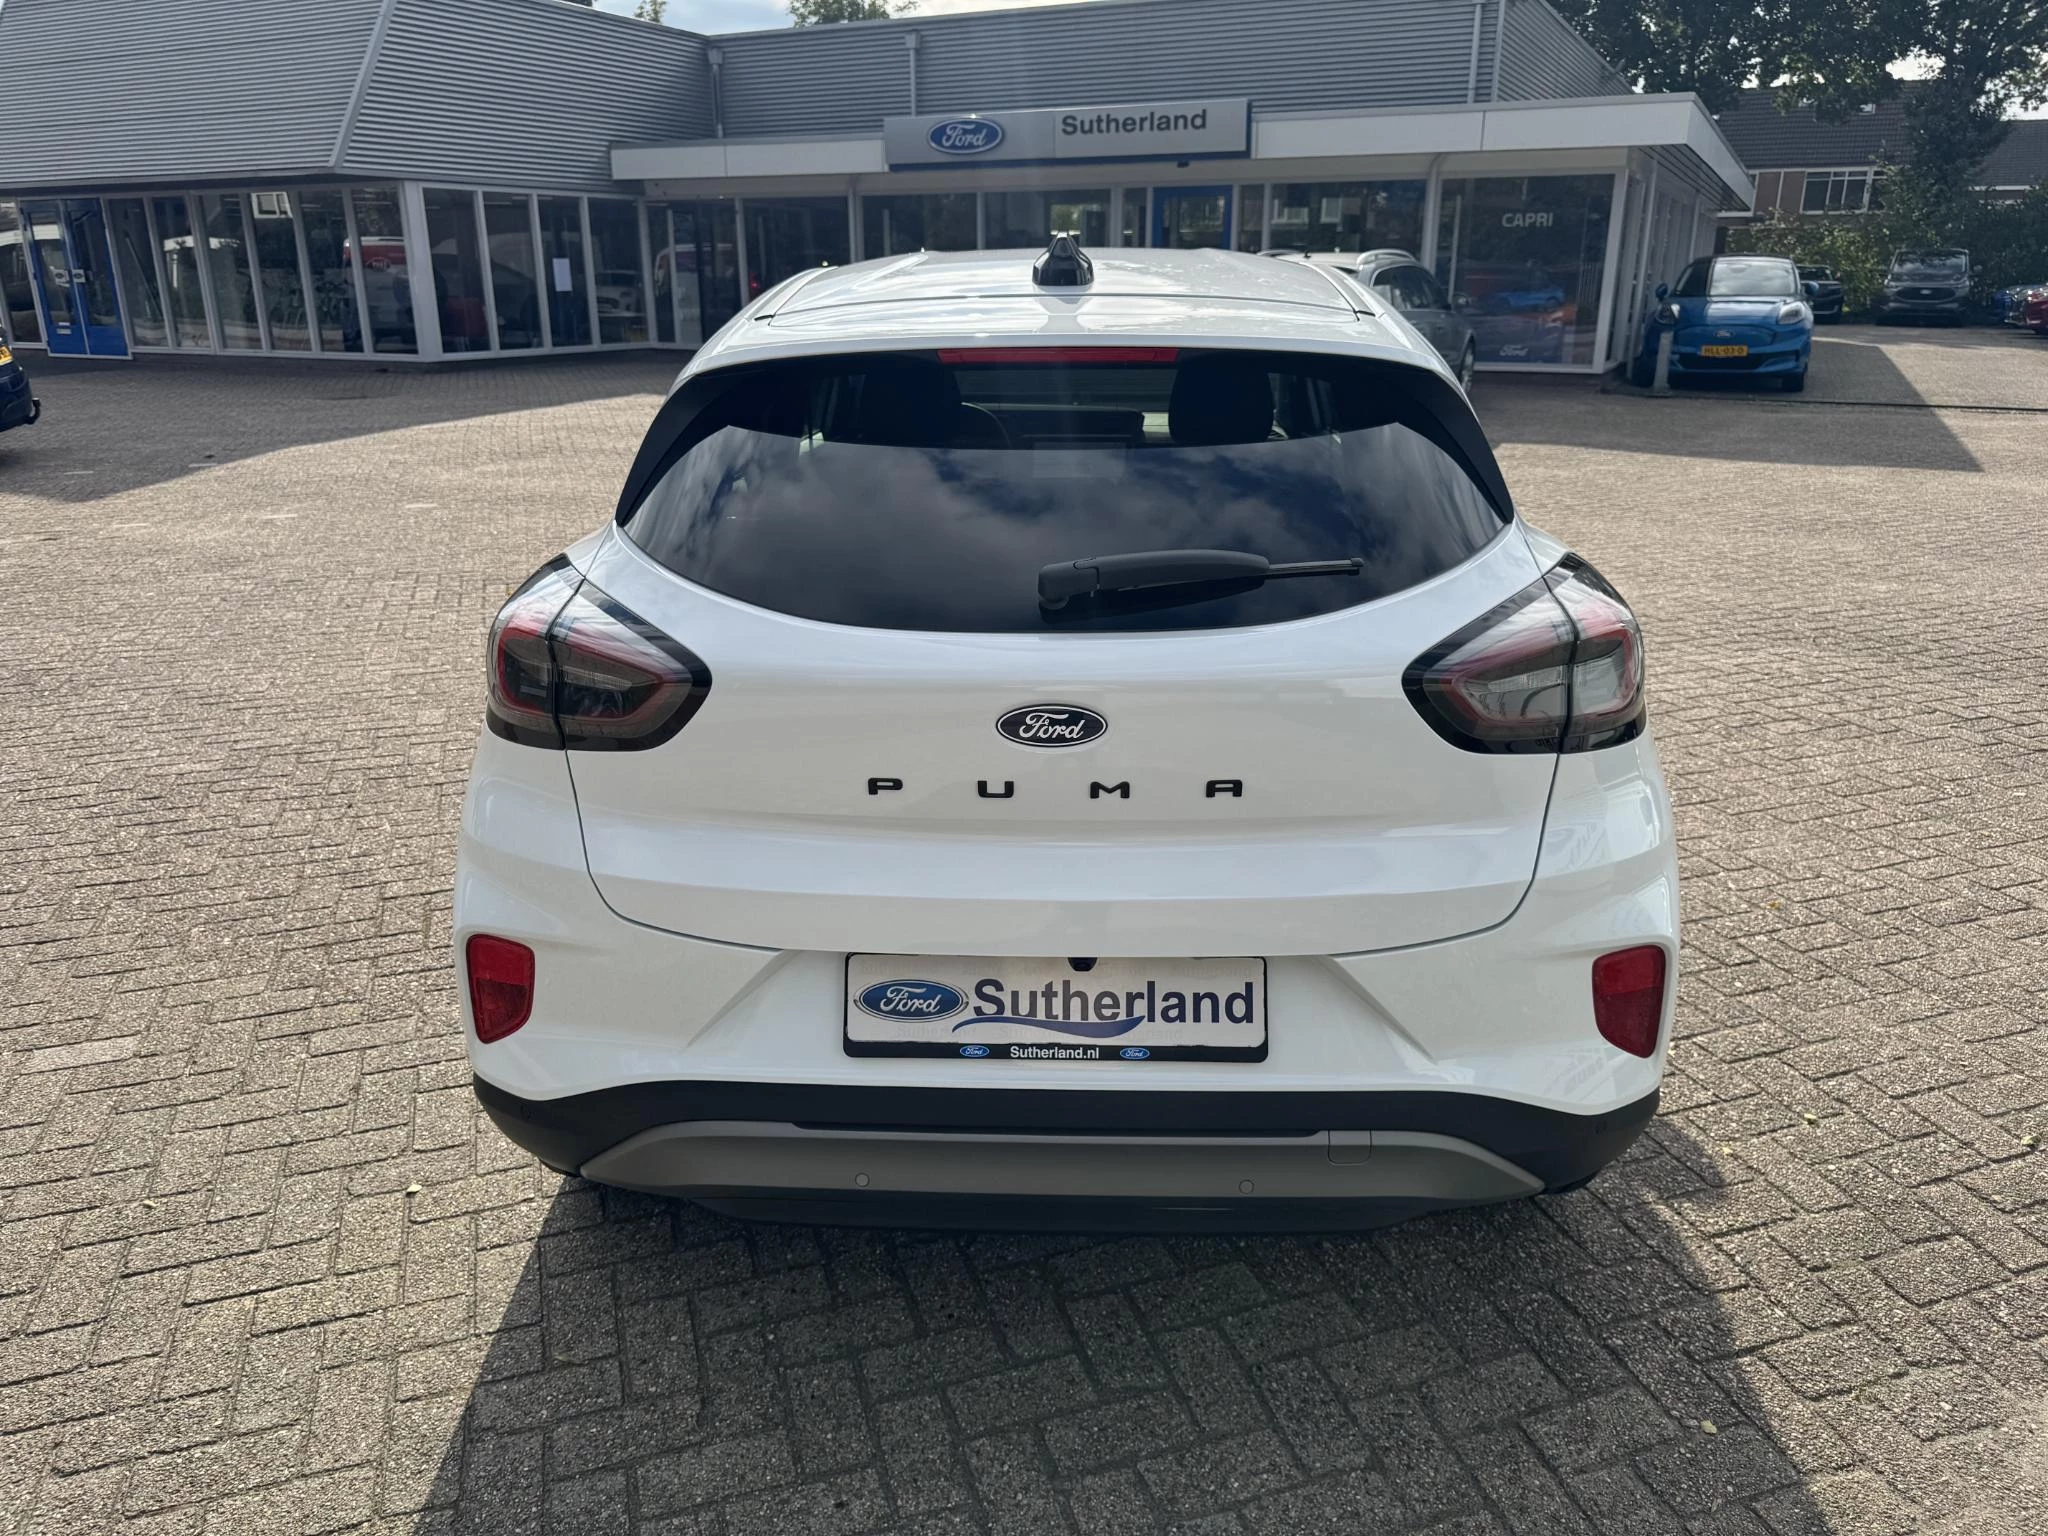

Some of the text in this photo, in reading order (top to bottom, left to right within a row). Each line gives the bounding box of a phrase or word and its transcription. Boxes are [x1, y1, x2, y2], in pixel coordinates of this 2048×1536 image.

[942, 123, 988, 147] Ford
[1061, 109, 1207, 136] Sutherland
[1502, 212, 1553, 227] CAPRI
[1019, 712, 1084, 739] Ford
[879, 986, 941, 1013] Ford
[973, 978, 1254, 1024] Sutherland
[965, 1047, 984, 1055] Ford
[1010, 1046, 1100, 1060] Sutherland.nl
